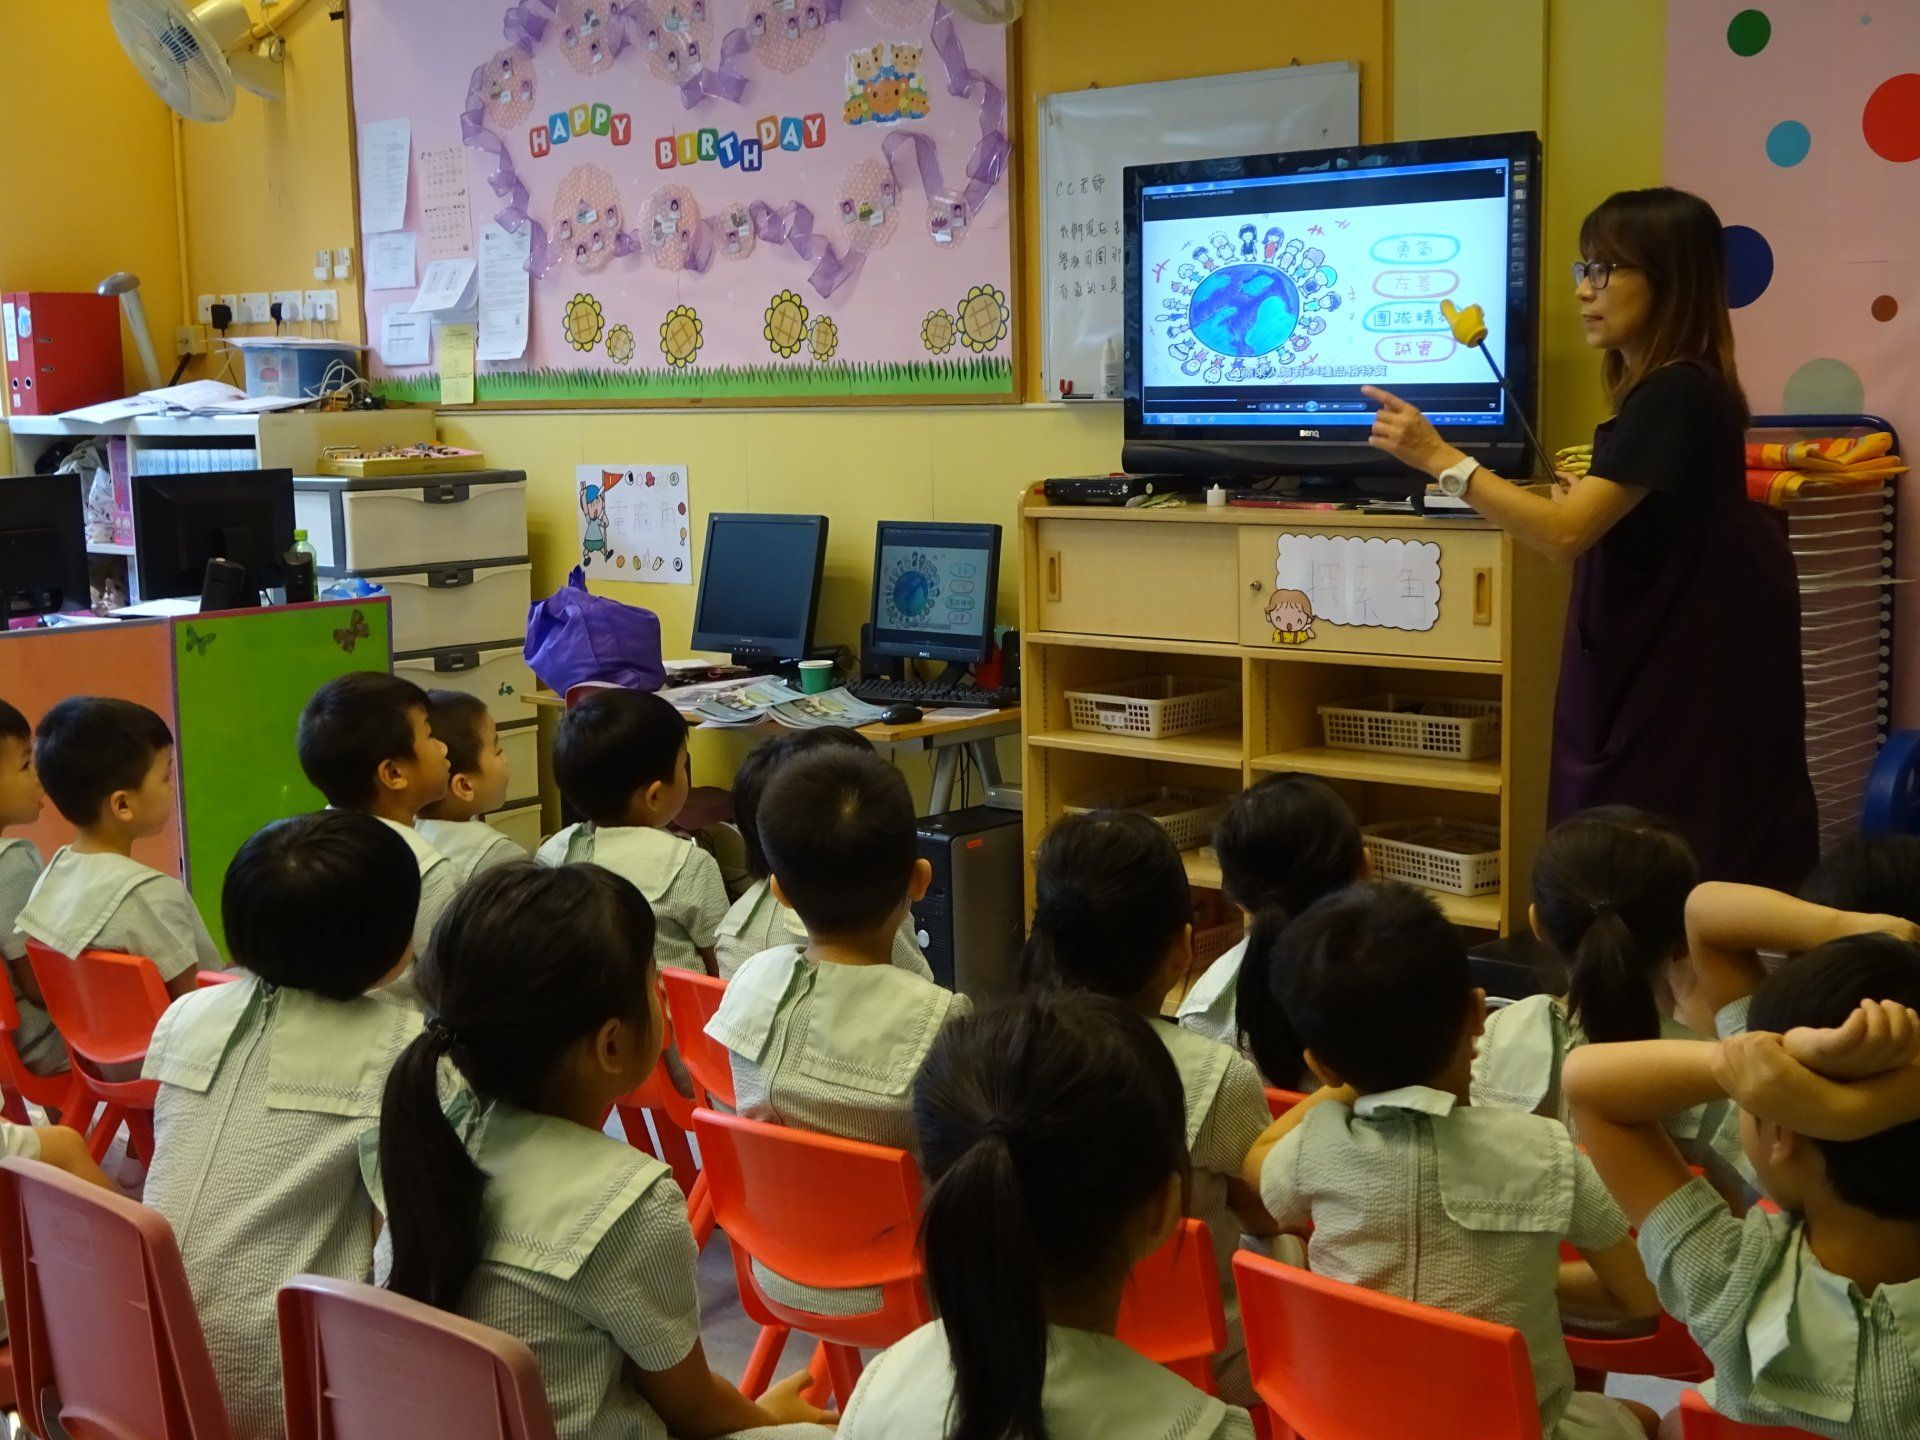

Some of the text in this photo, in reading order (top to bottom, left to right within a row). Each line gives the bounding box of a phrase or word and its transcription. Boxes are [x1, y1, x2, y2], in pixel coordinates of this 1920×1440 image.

[531, 106, 823, 169] HAPPY BIRTHDAY
[1396, 240, 1433, 258] 勇氣
[1394, 275, 1432, 292] 友善
[1394, 340, 1433, 357] 誠實
[608, 501, 677, 536] 電腦角
